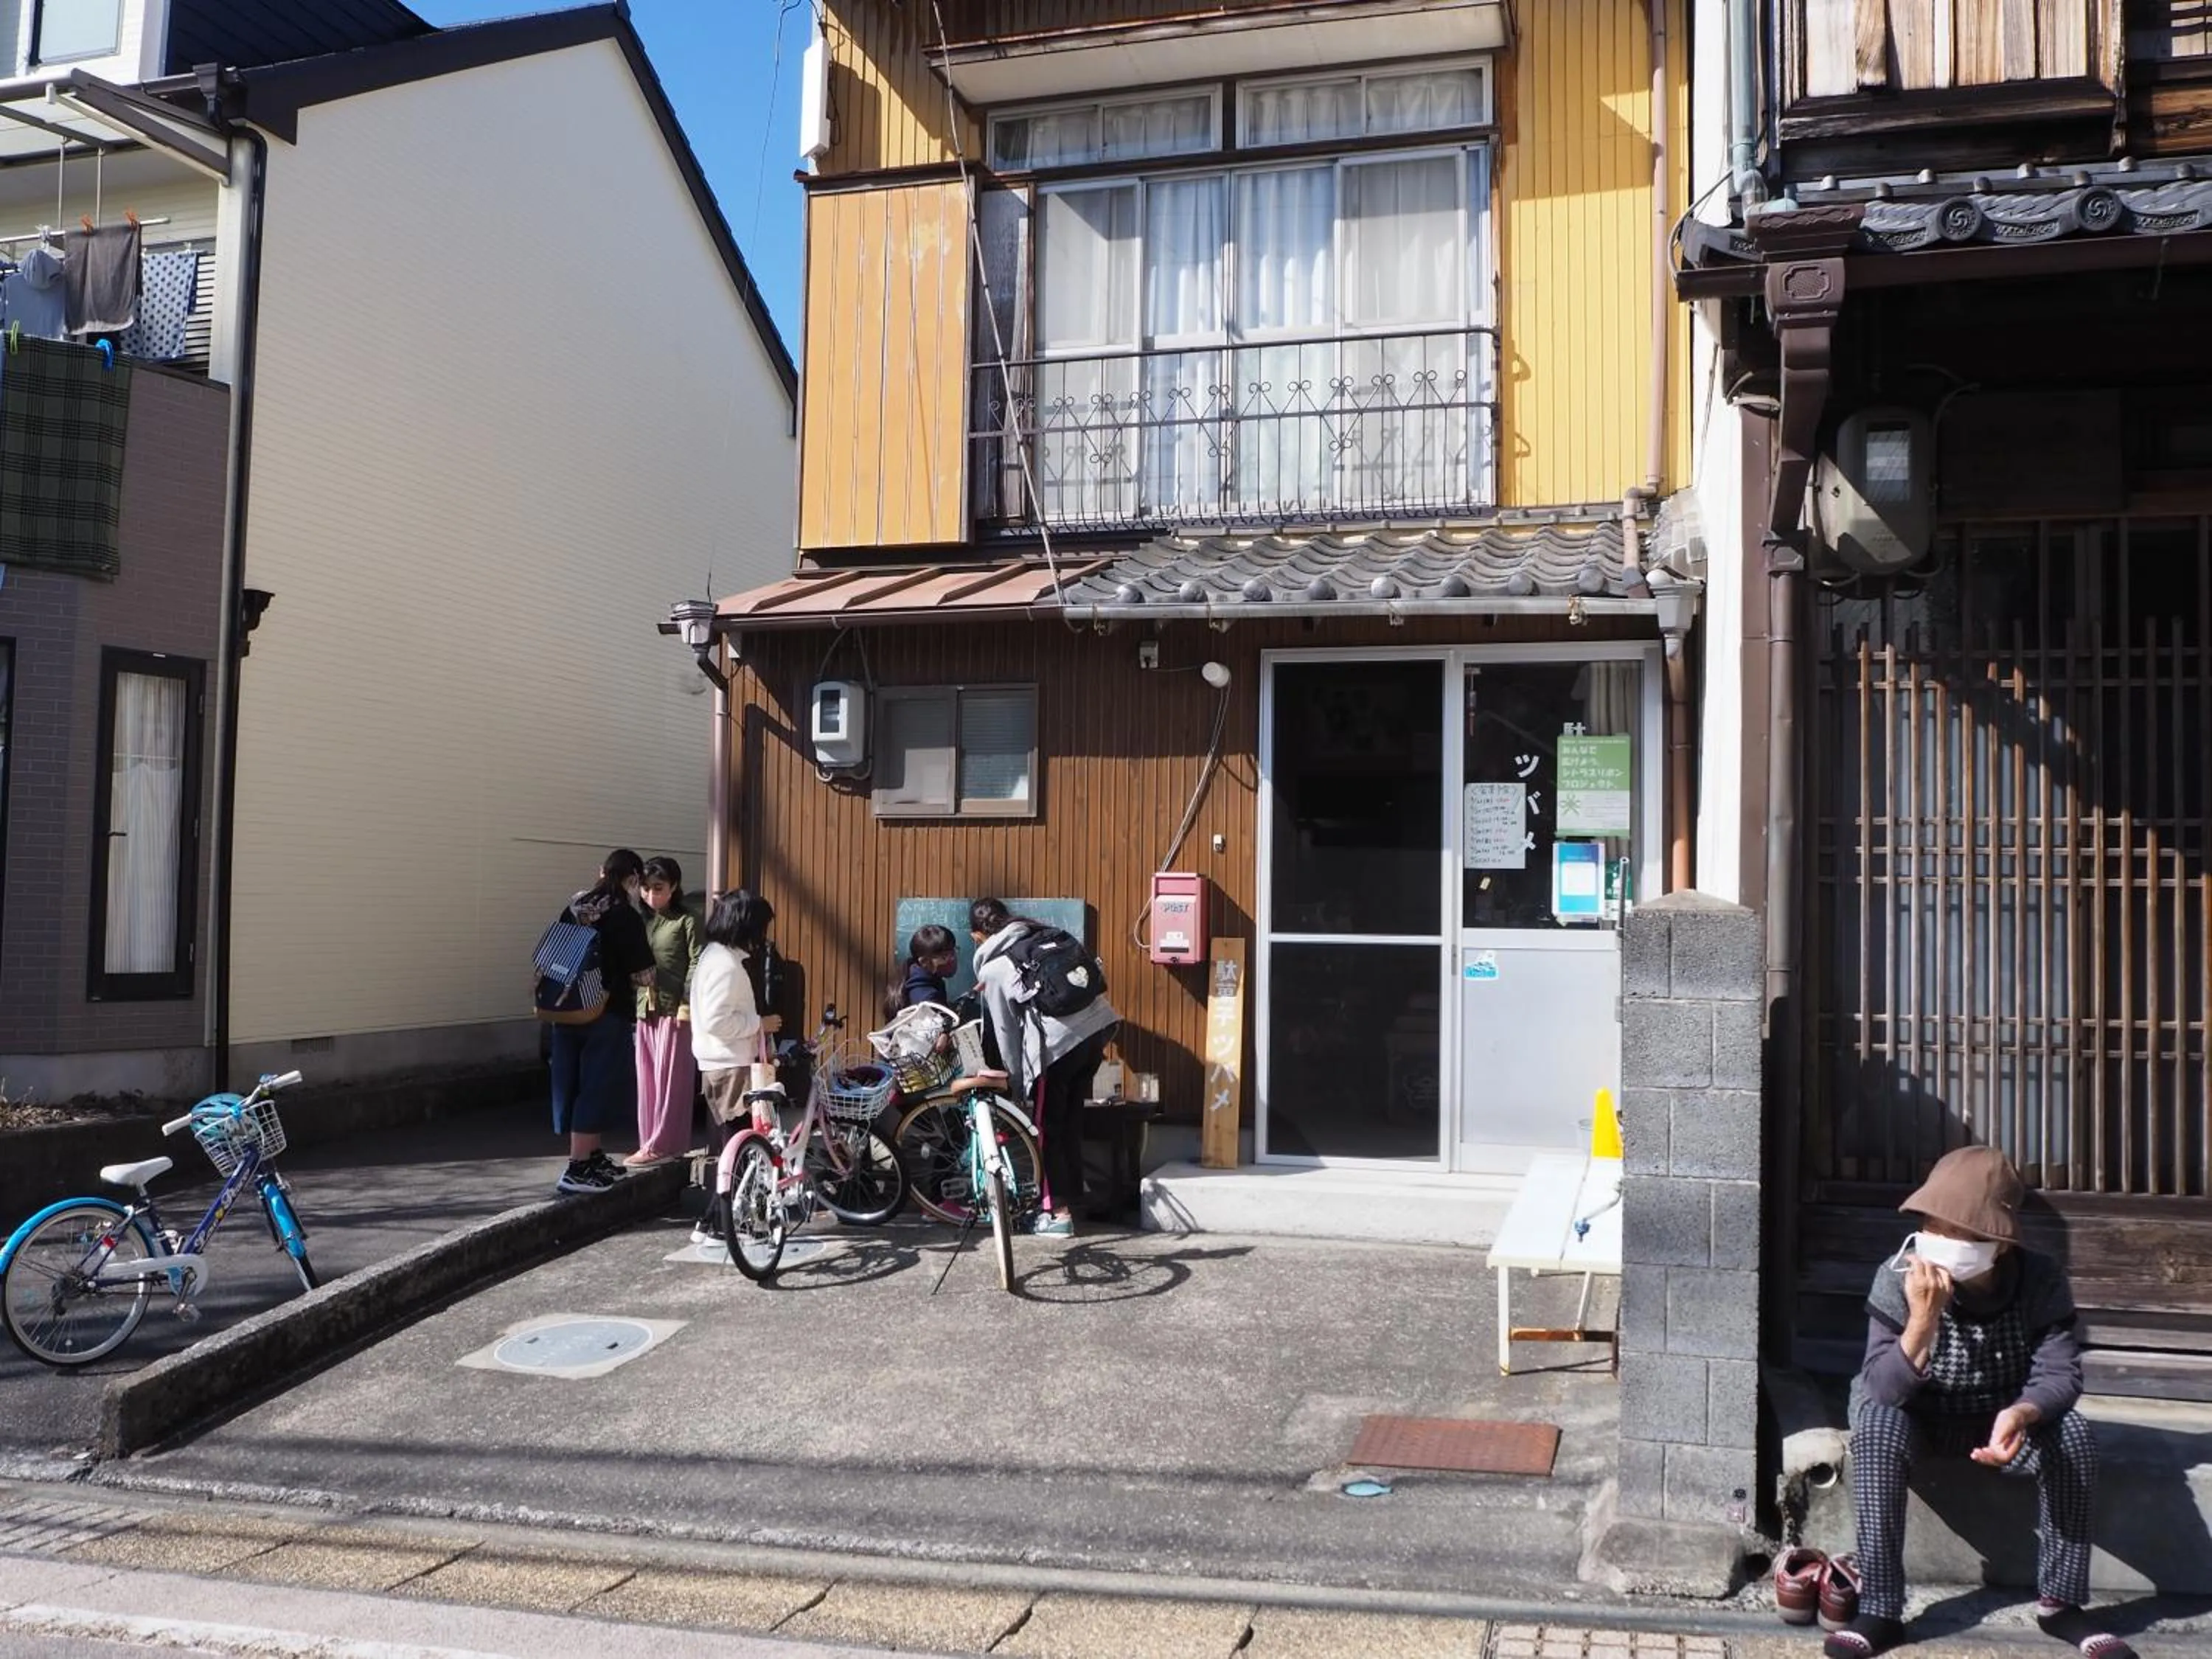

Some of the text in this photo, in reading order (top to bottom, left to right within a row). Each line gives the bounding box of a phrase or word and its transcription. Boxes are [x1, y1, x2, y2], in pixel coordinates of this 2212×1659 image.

[1562, 768, 1625, 778] シトラスリボン
[1163, 902, 1189, 913] POST
